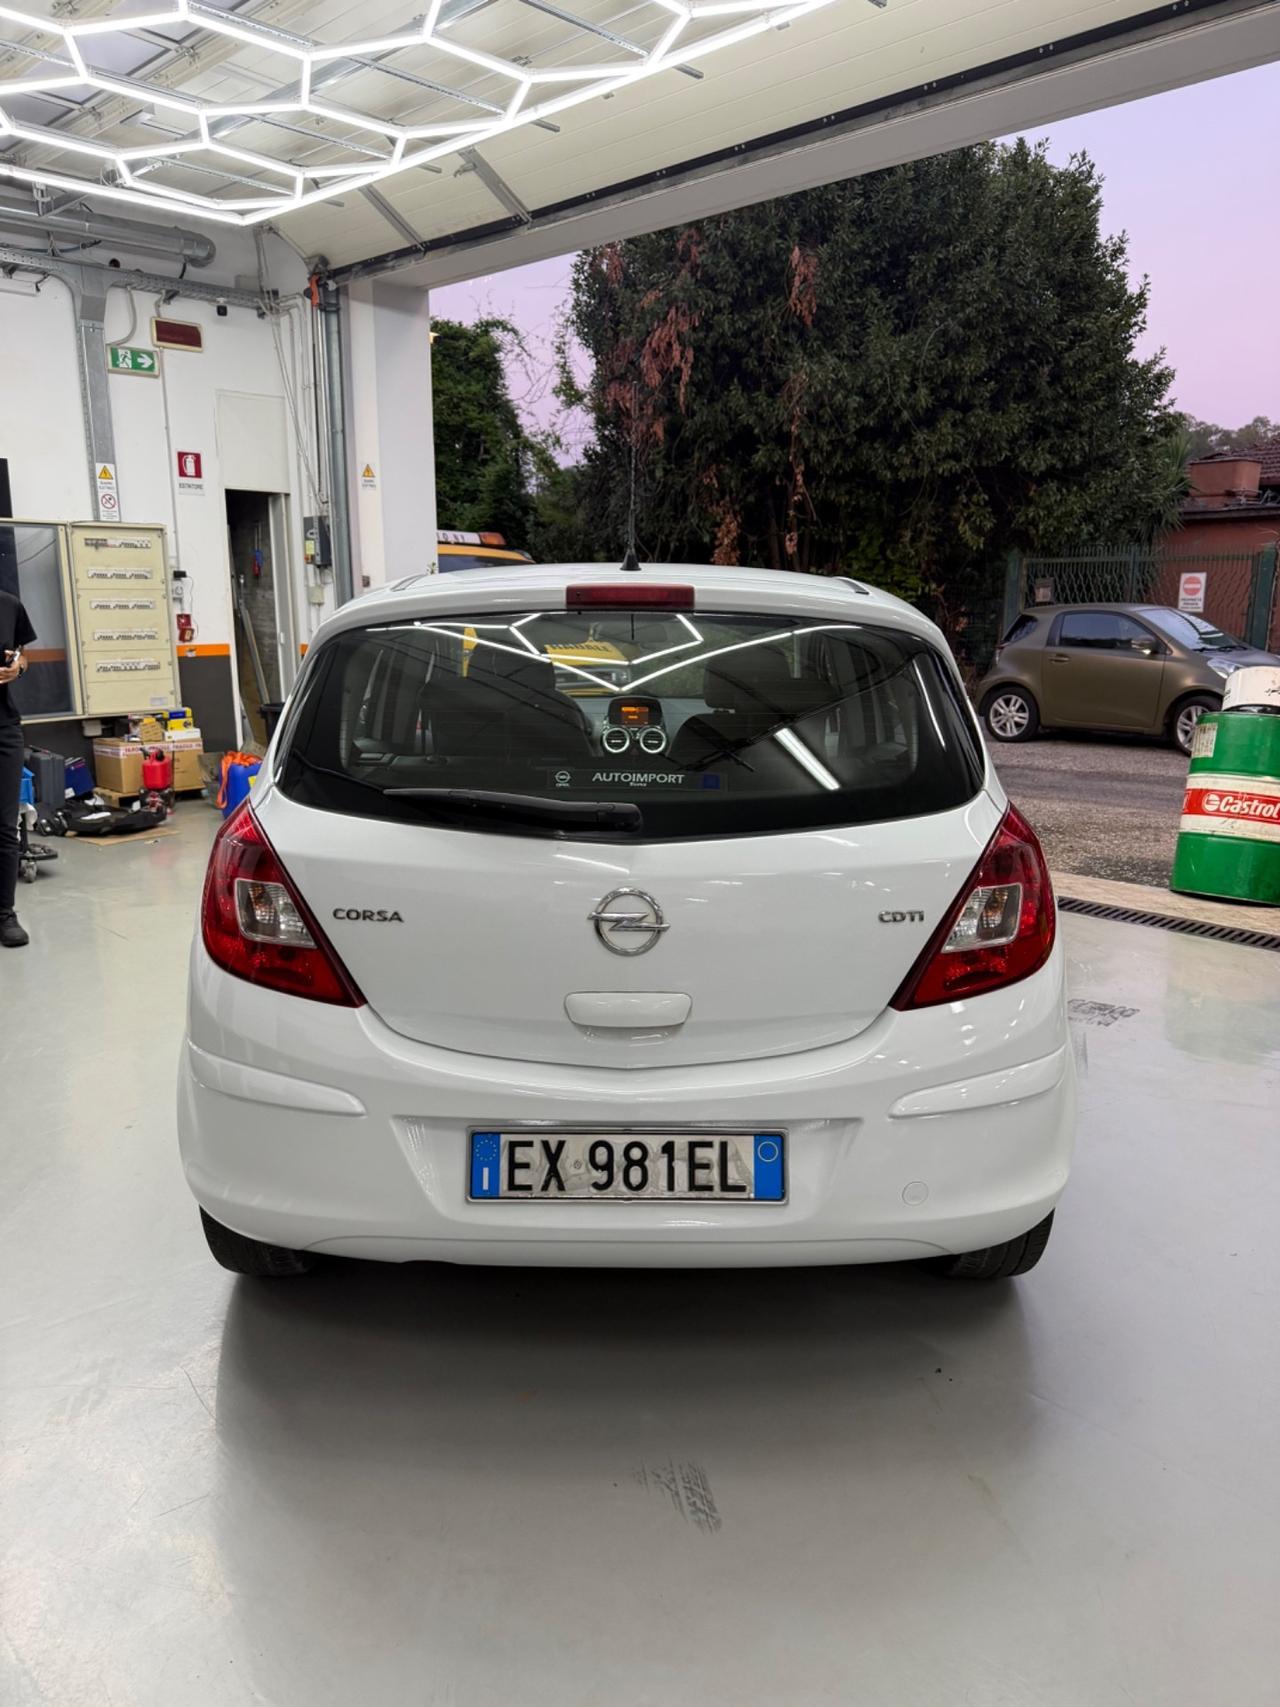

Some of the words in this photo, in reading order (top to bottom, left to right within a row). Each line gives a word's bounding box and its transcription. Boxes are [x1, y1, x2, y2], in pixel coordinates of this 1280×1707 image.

[592, 772, 685, 784] AUTOIMPORT
[1220, 796, 1280, 818] Castrol
[333, 908, 404, 923] CORSA
[508, 1140, 566, 1192] EX
[588, 1140, 747, 1192] 981EL
